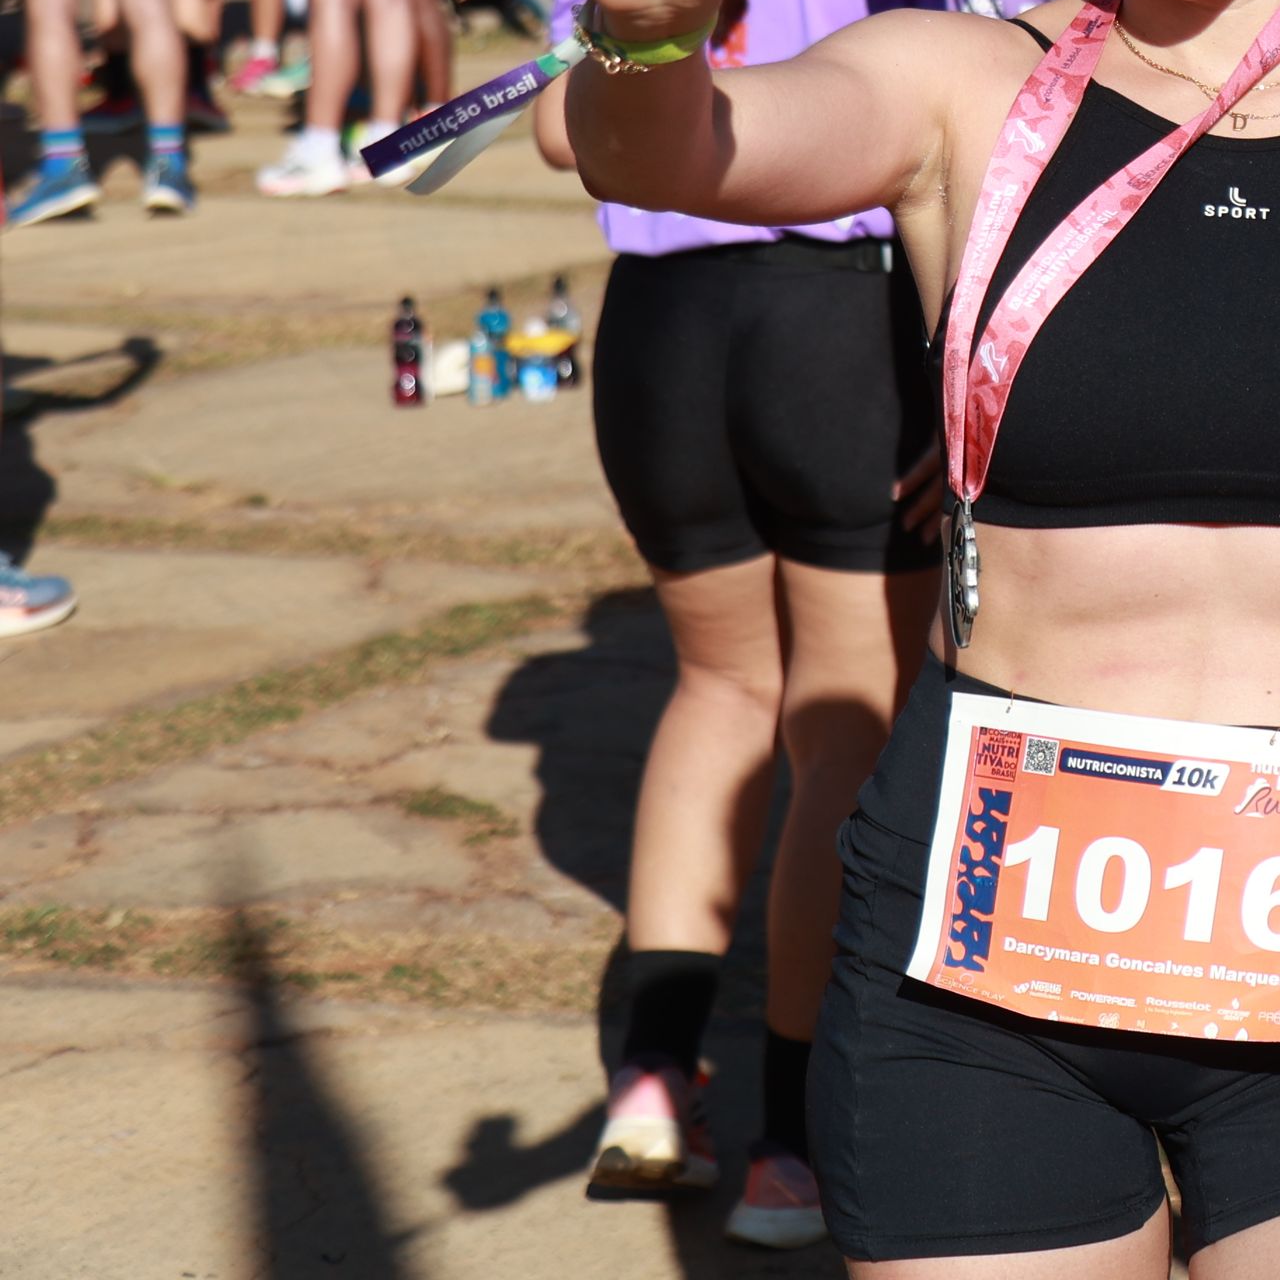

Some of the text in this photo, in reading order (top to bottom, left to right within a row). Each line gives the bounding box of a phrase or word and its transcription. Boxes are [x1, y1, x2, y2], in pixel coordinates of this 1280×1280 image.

[399, 72, 539, 155] nutrição brasil
[1204, 205, 1271, 220] SPORT
[1077, 208, 1119, 245] BRASIL
[976, 752, 1004, 769] TIVA
[981, 742, 1020, 759] NUTRI
[1067, 756, 1163, 781] NUTRICIONISTA
[1172, 766, 1219, 790] 10k
[1003, 936, 1100, 967] Darcymara
[1105, 952, 1204, 978] Goncalves
[1145, 996, 1212, 1012] Rousselot
